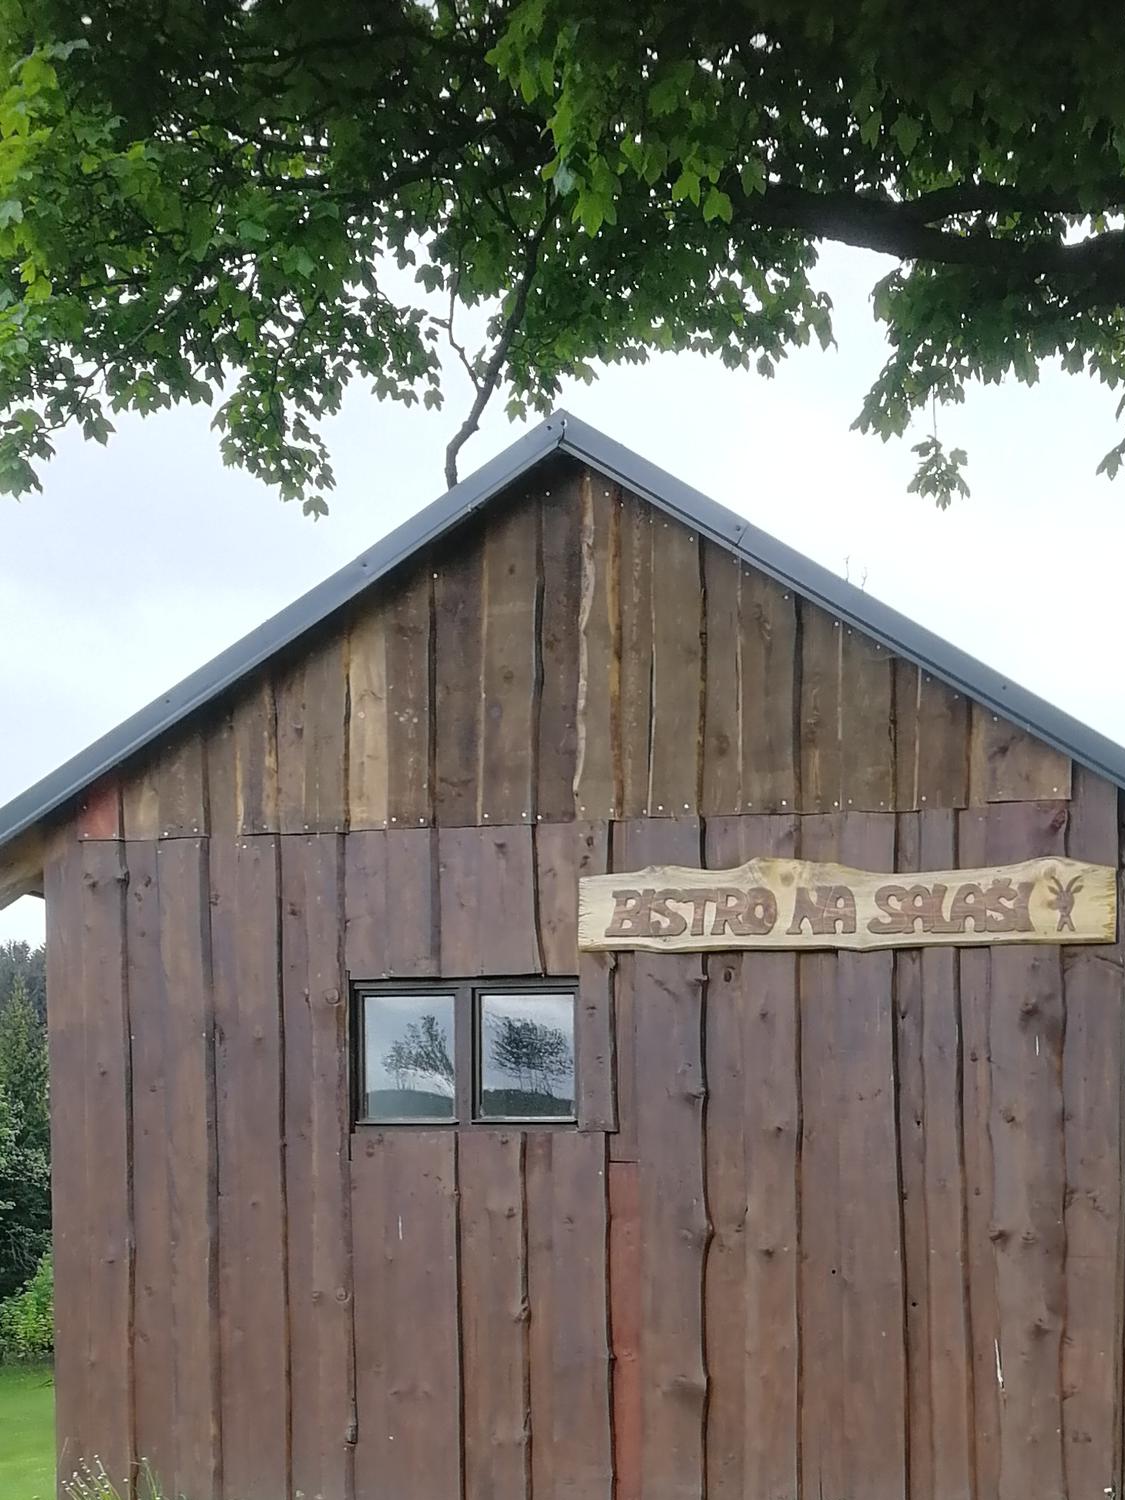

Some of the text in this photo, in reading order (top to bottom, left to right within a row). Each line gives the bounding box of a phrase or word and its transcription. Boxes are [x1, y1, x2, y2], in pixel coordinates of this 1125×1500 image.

[604, 878, 1035, 937] BISTRO NA SALAŠI
